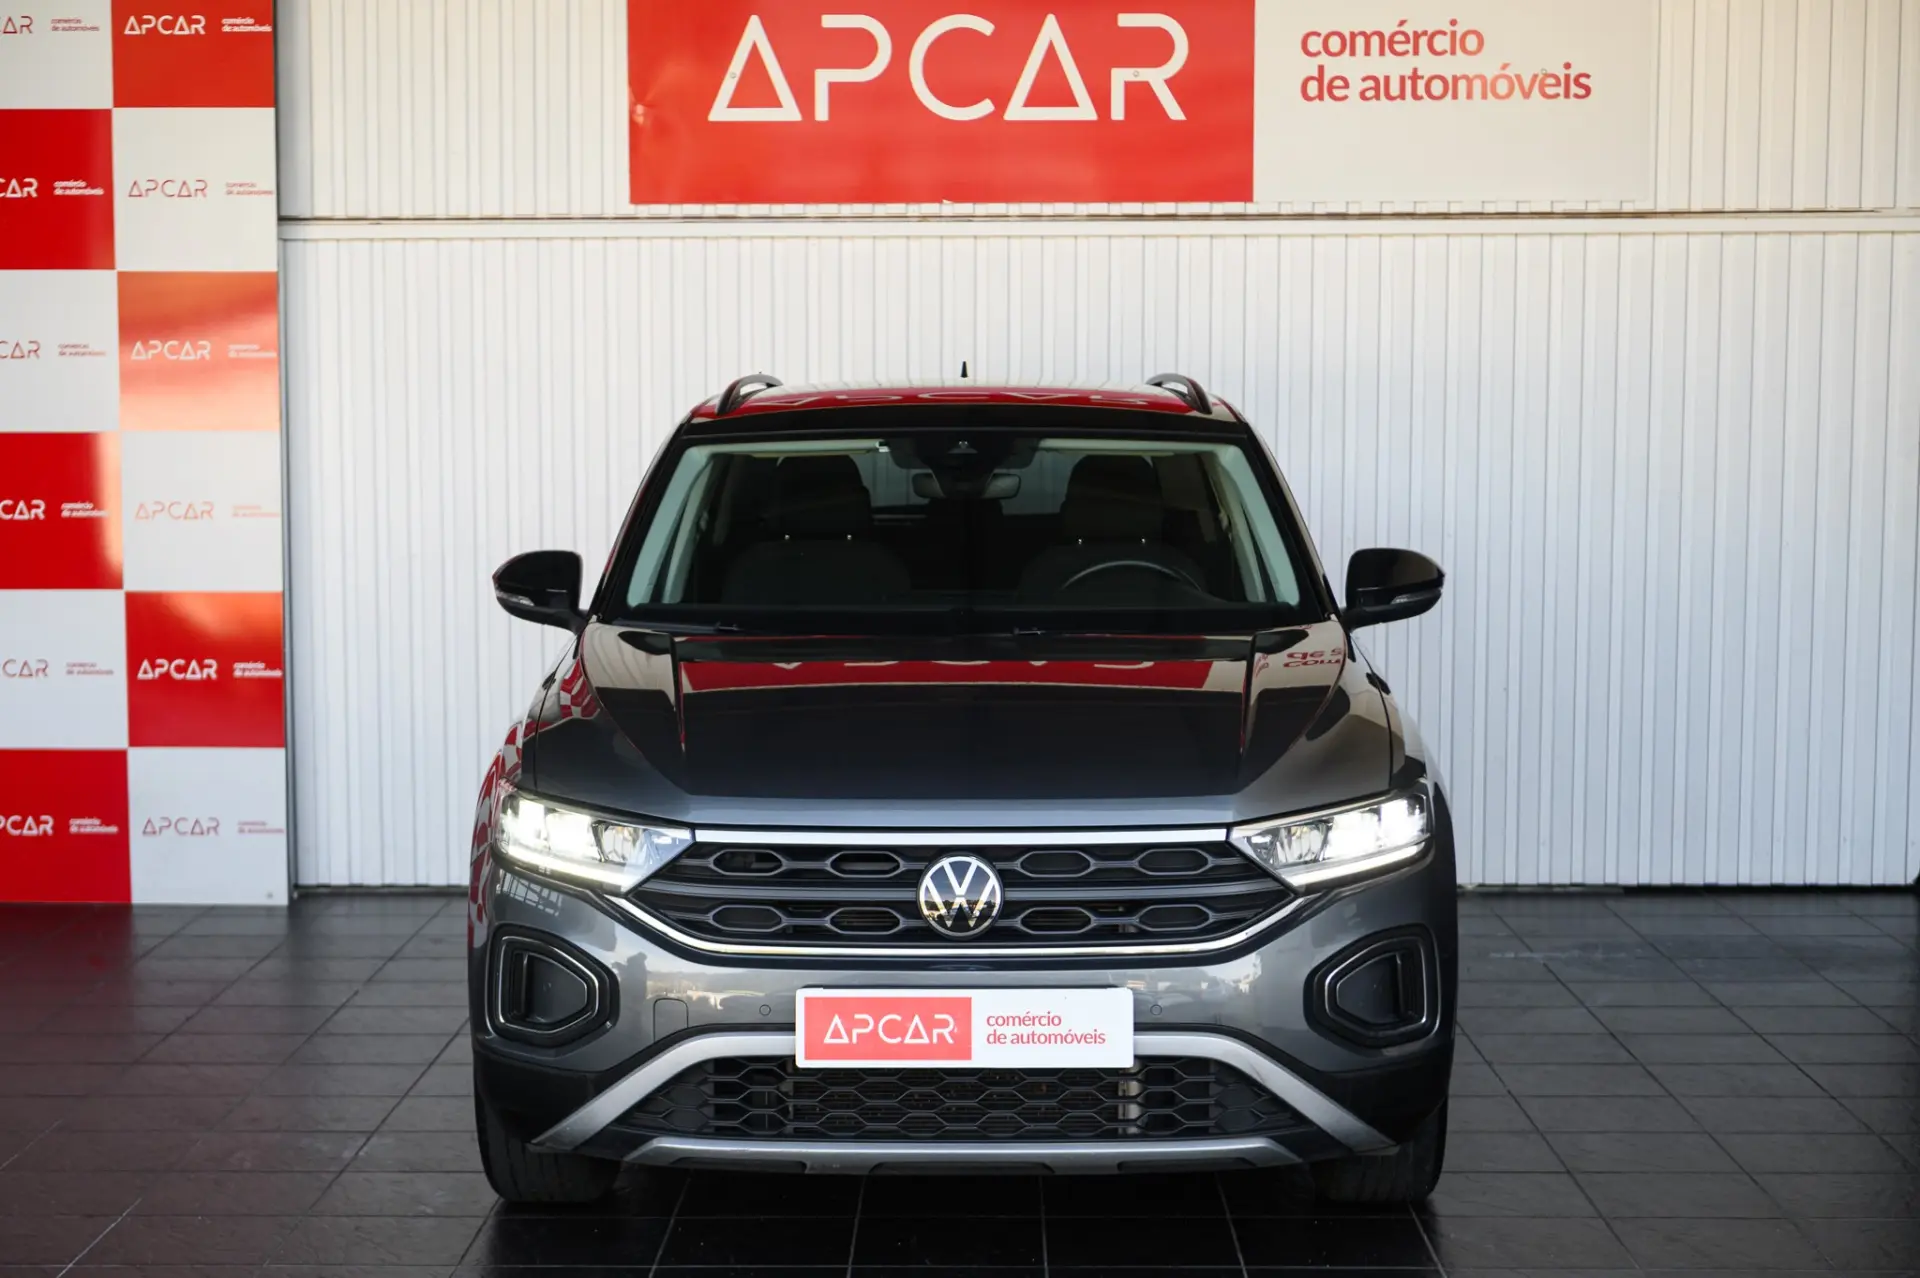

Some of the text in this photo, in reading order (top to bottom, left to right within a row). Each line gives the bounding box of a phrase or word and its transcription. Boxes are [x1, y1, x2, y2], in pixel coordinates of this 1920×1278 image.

[124, 14, 206, 35] APCAR
[1300, 18, 1485, 58] comércio
[708, 12, 1188, 122] APCAR
[1300, 62, 1592, 102] de automóveis
[128, 179, 208, 198] APCAR
[130, 340, 211, 360] APCAR
[134, 500, 214, 520] APCAR
[137, 658, 218, 680] APCAR
[142, 816, 220, 836] APCAR
[824, 1013, 955, 1045] APCAR
[986, 1011, 1062, 1027] comércio
[986, 1027, 1106, 1045] de automóveis
